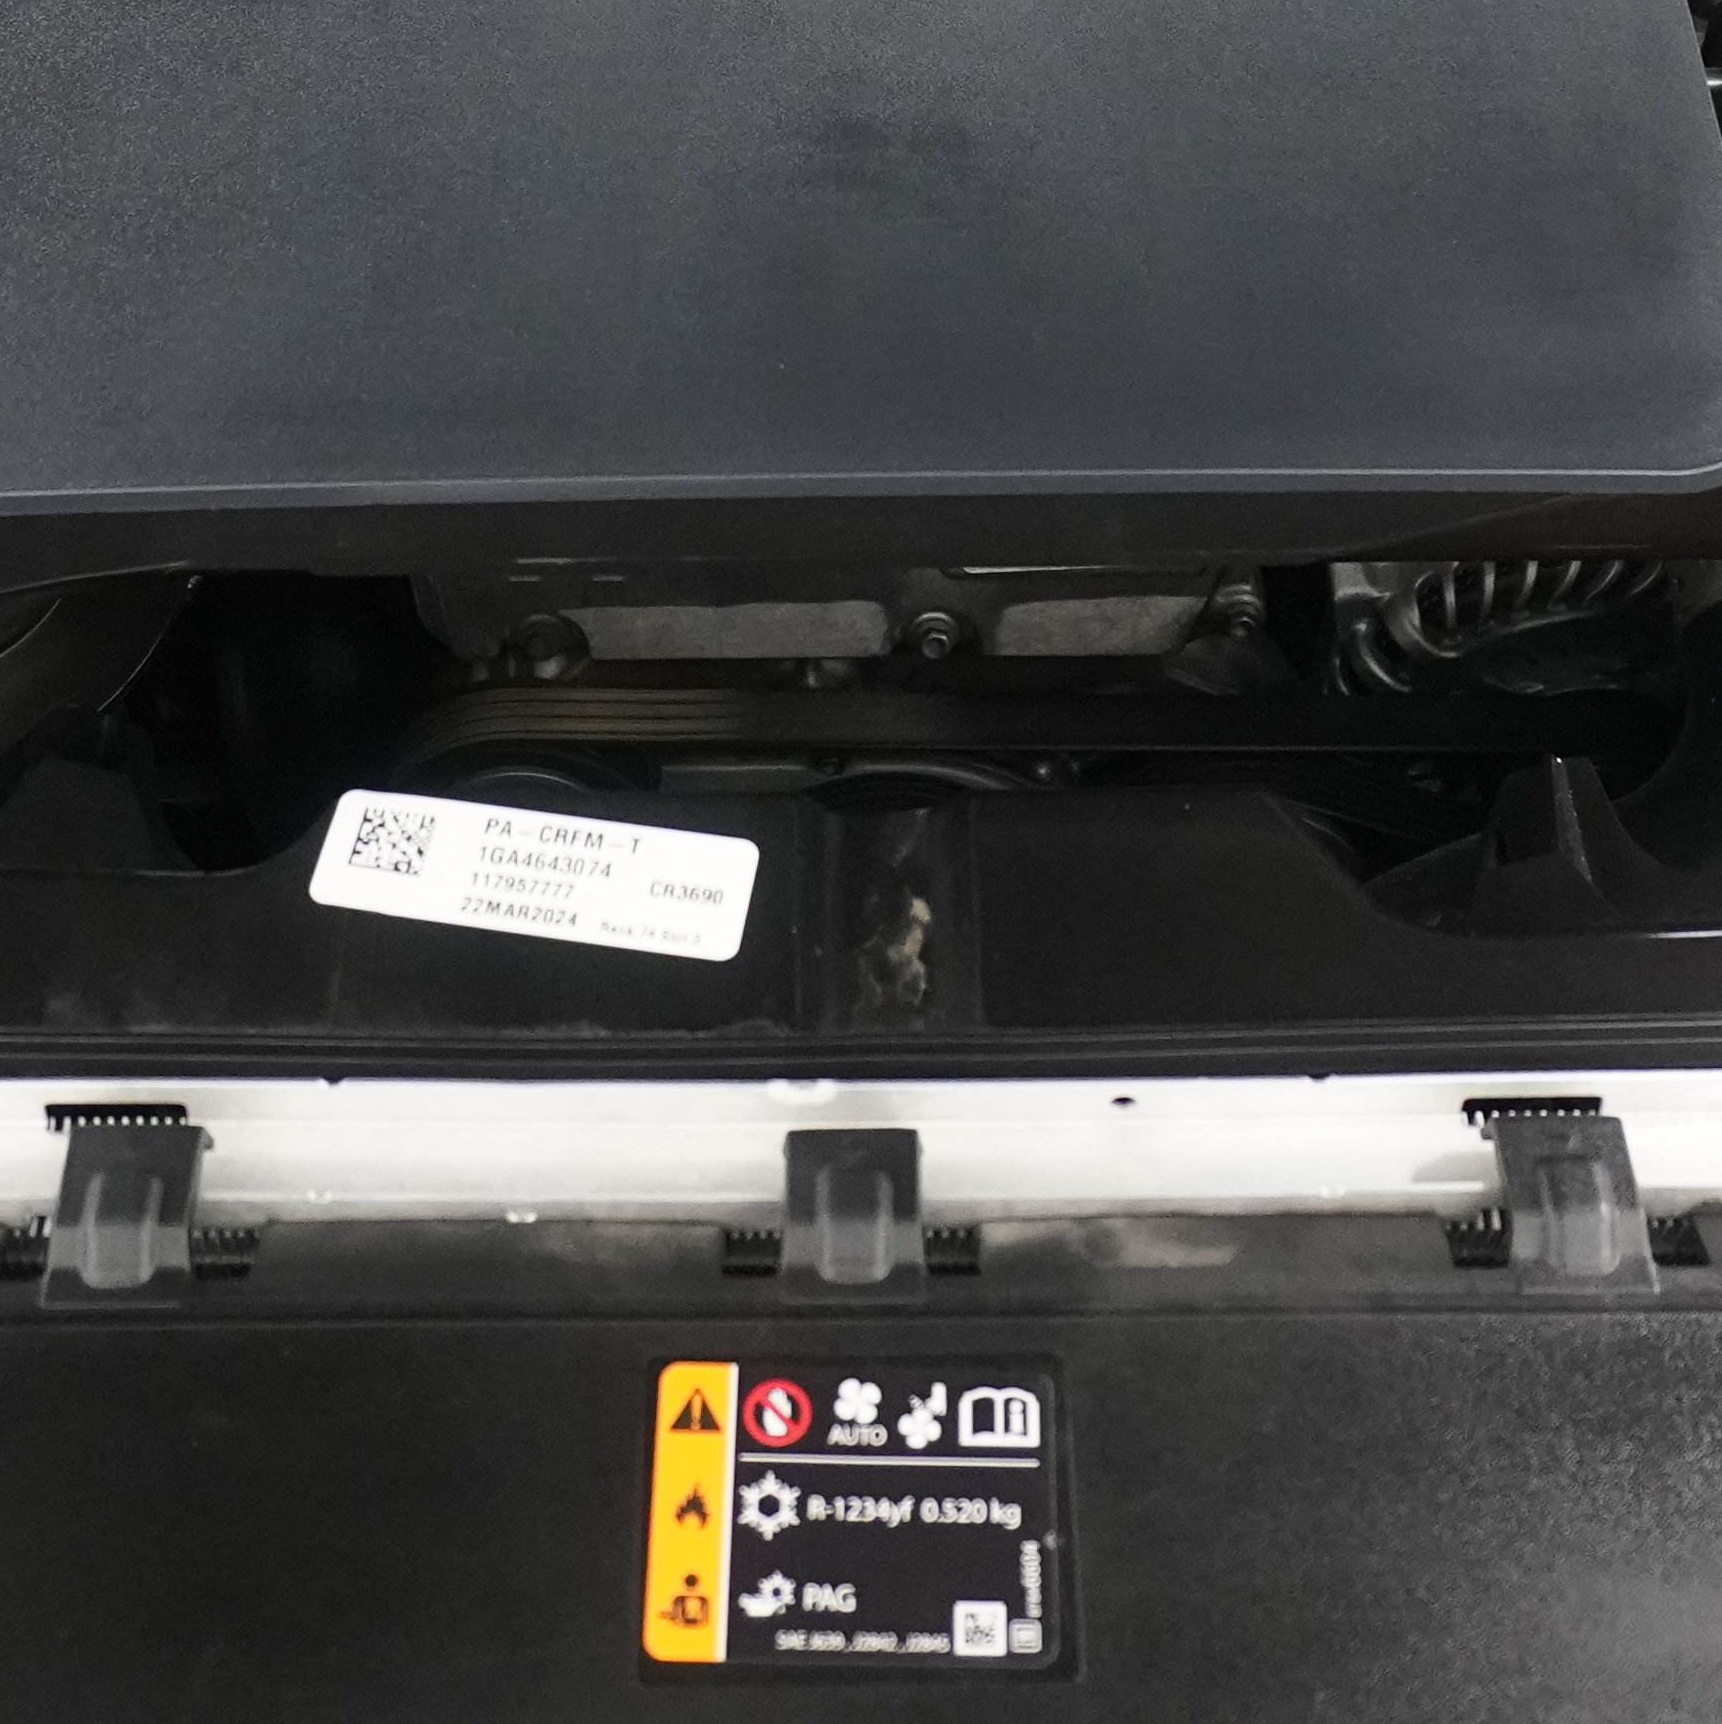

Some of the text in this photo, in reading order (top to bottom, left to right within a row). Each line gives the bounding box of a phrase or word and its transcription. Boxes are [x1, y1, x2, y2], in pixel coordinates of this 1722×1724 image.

[460, 896, 579, 927] 22MAR2024
[827, 1423, 889, 1447] AUTO
[806, 1493, 1023, 1531] R-1234yf 0.520 kg
[802, 1581, 857, 1614] PAG
